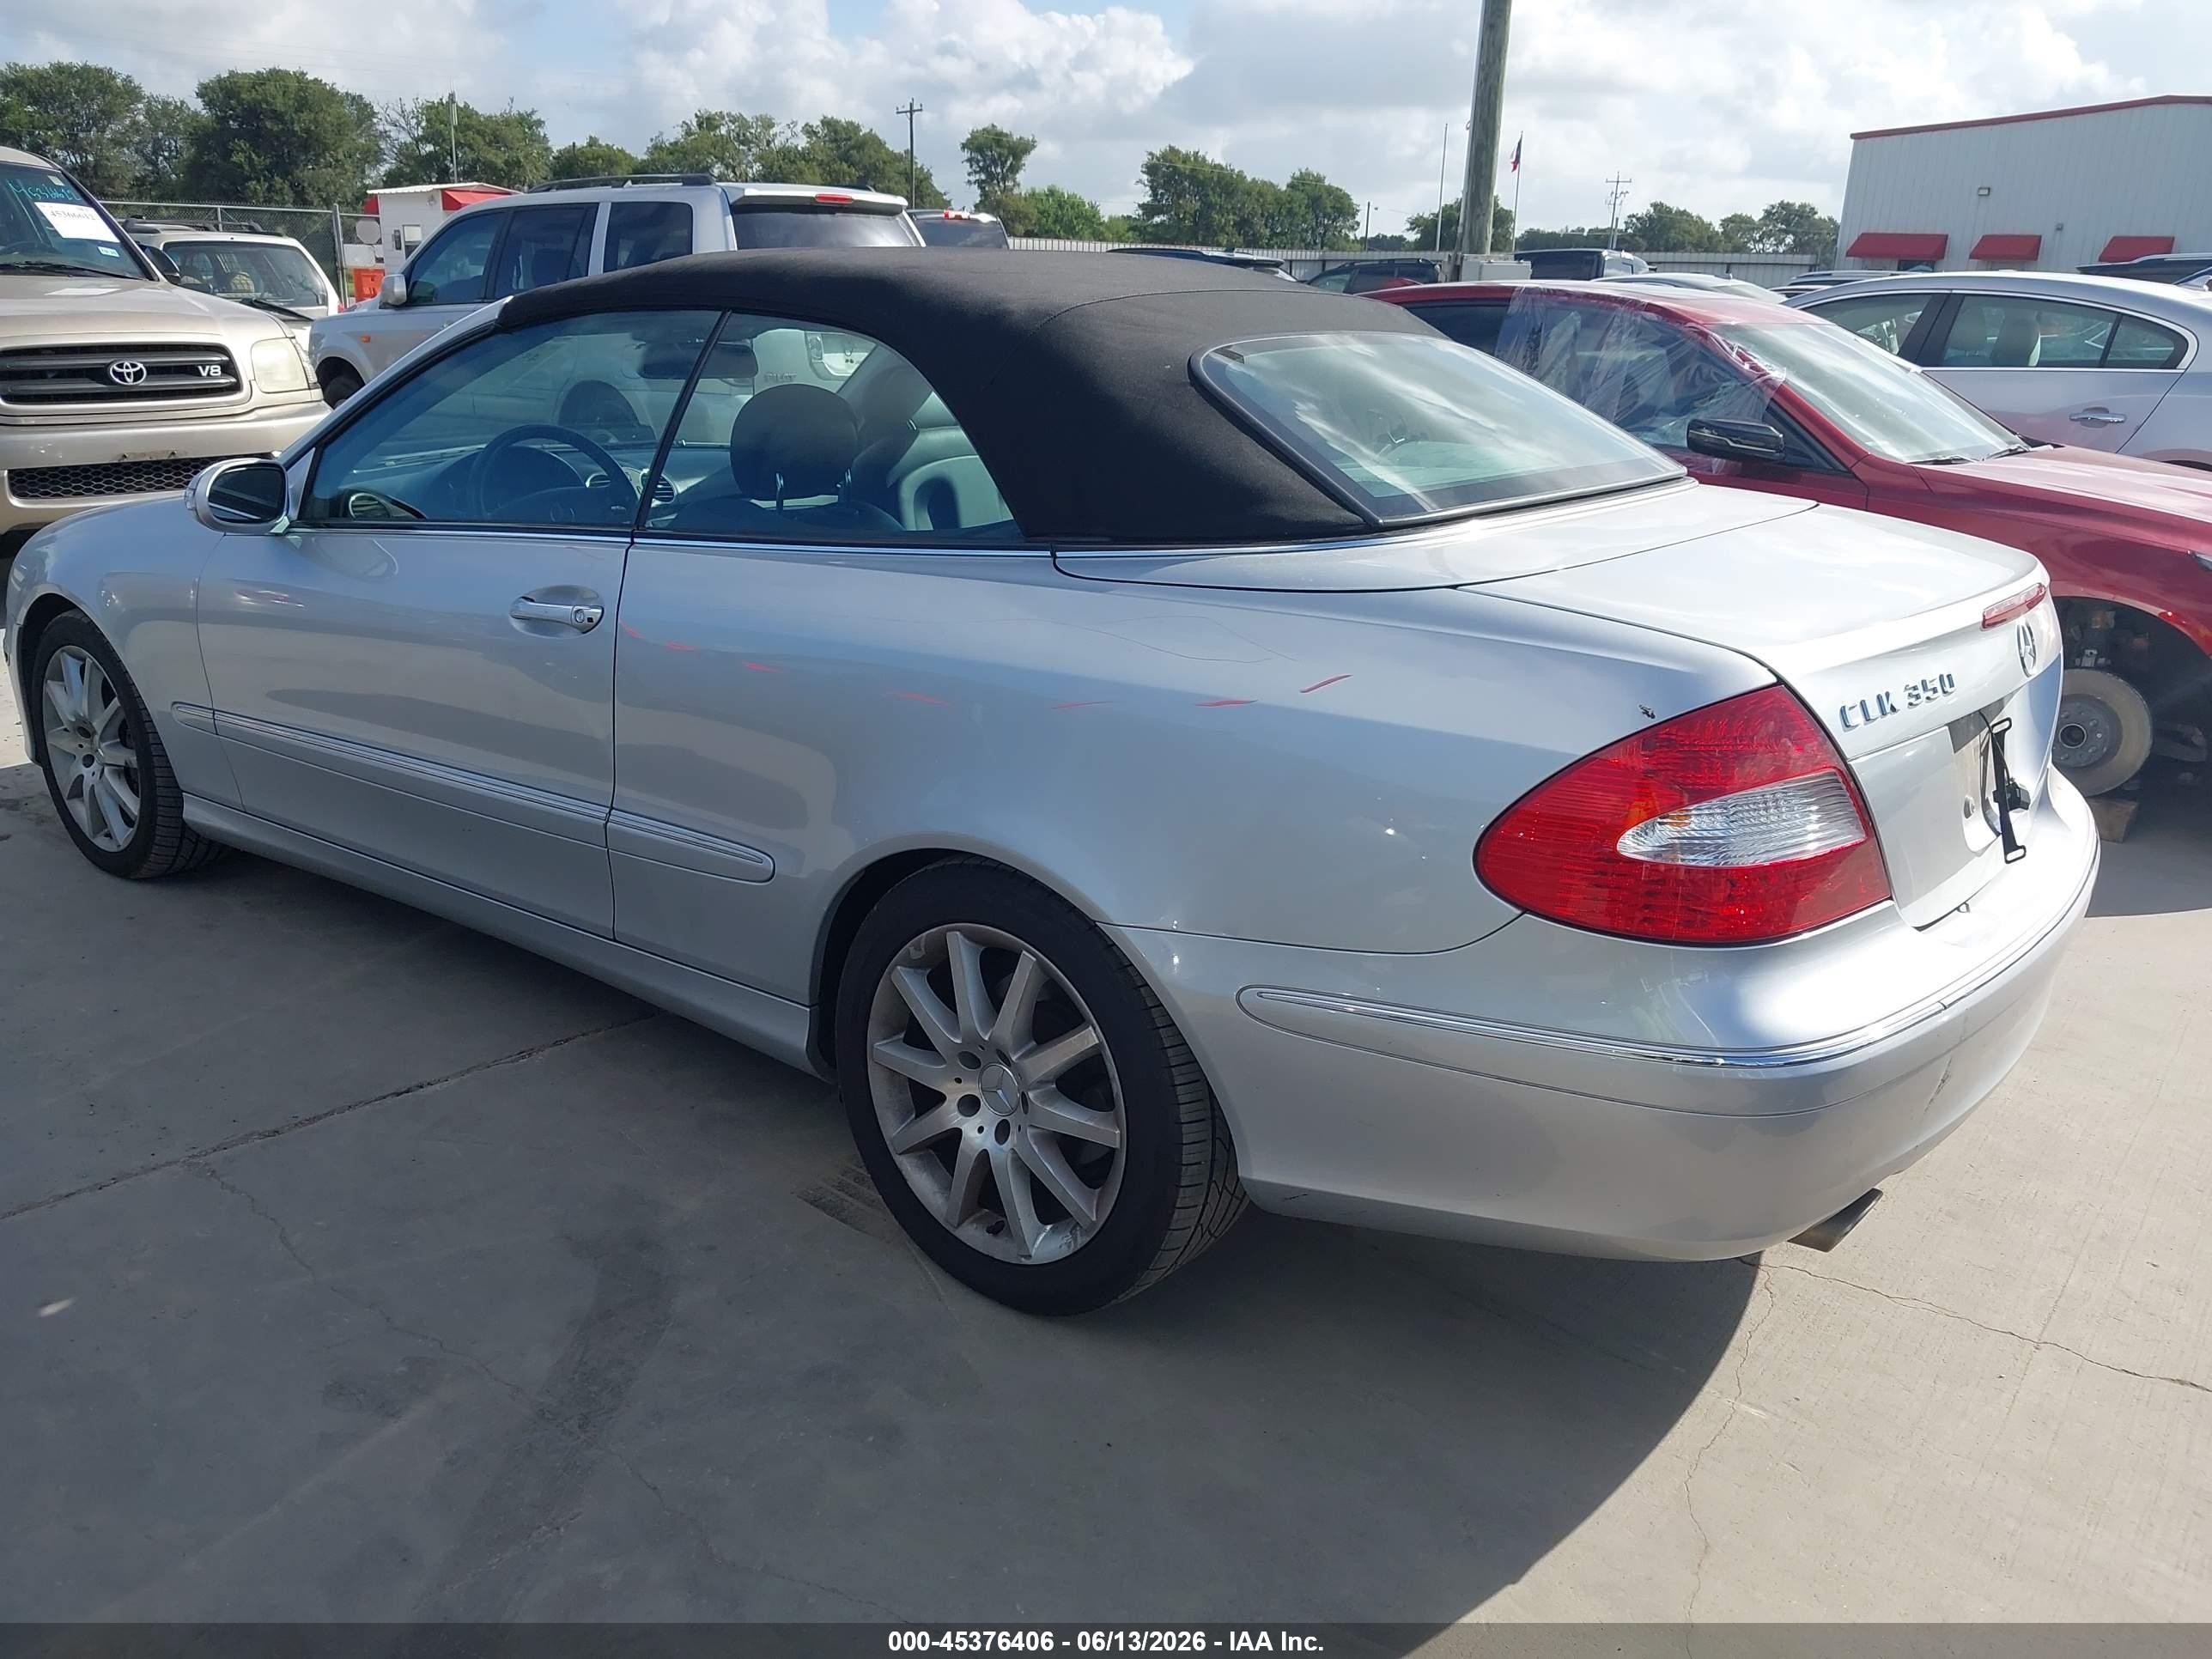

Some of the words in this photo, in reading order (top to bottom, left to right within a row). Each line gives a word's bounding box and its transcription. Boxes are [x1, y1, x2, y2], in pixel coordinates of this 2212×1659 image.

[198, 365, 222, 377] V8
[1839, 690, 1899, 731] CLK
[1903, 673, 1957, 709] 350
